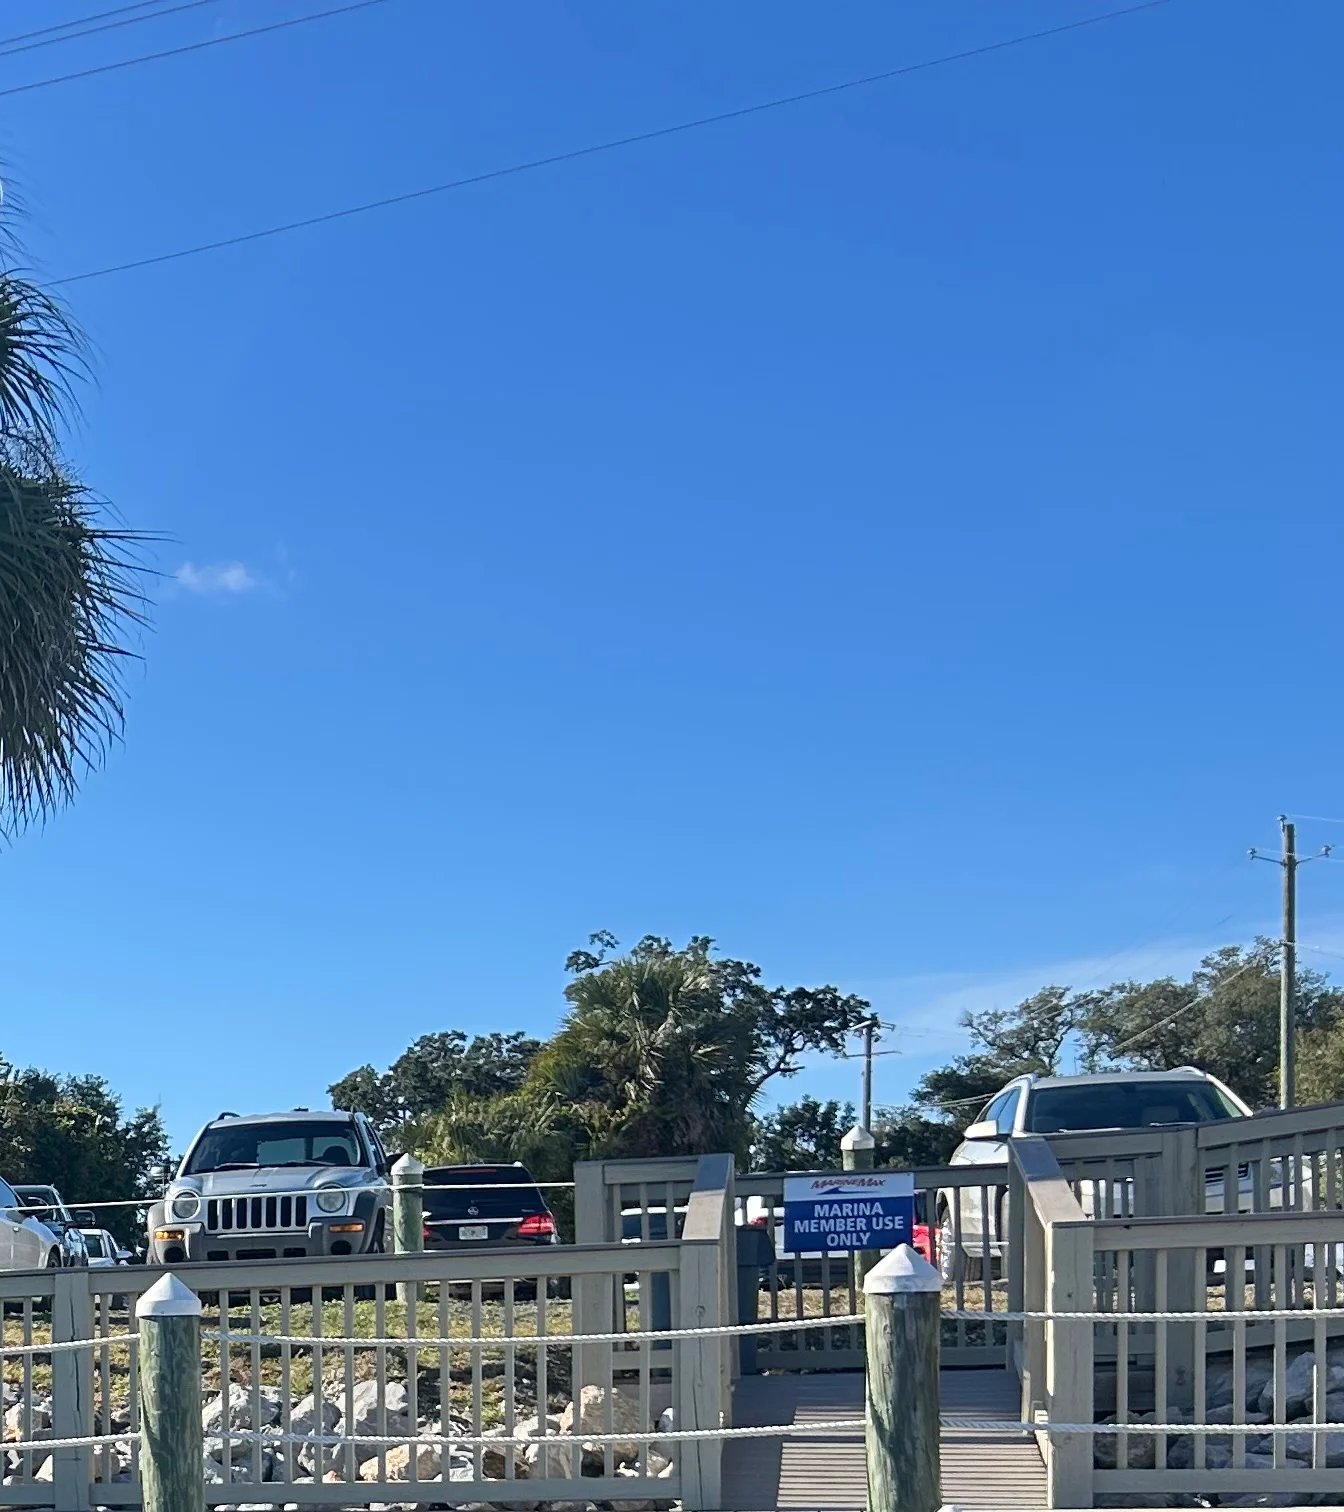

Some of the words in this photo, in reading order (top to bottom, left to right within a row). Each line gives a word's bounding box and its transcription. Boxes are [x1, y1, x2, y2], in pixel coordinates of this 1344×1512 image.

[814, 1202, 883, 1218] MARINA
[794, 1218, 867, 1233] MEMBER
[872, 1216, 904, 1230] USE
[826, 1232, 871, 1246] ONLY
